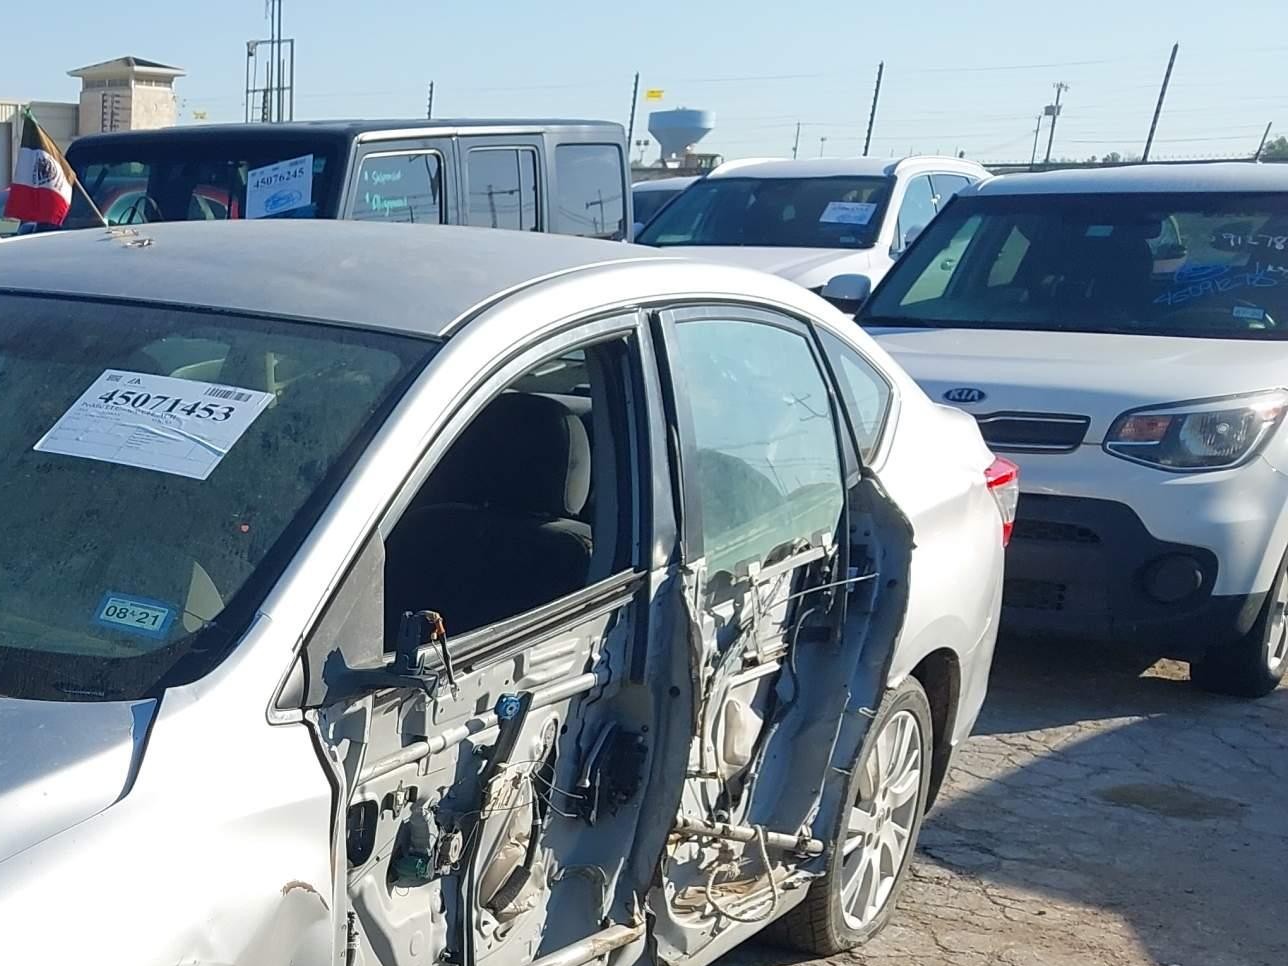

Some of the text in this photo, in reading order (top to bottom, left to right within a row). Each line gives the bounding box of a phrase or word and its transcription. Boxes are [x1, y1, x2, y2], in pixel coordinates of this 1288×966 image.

[948, 389, 980, 400] KIA
[99, 389, 235, 422] 45071453
[105, 605, 160, 626] 08 21
